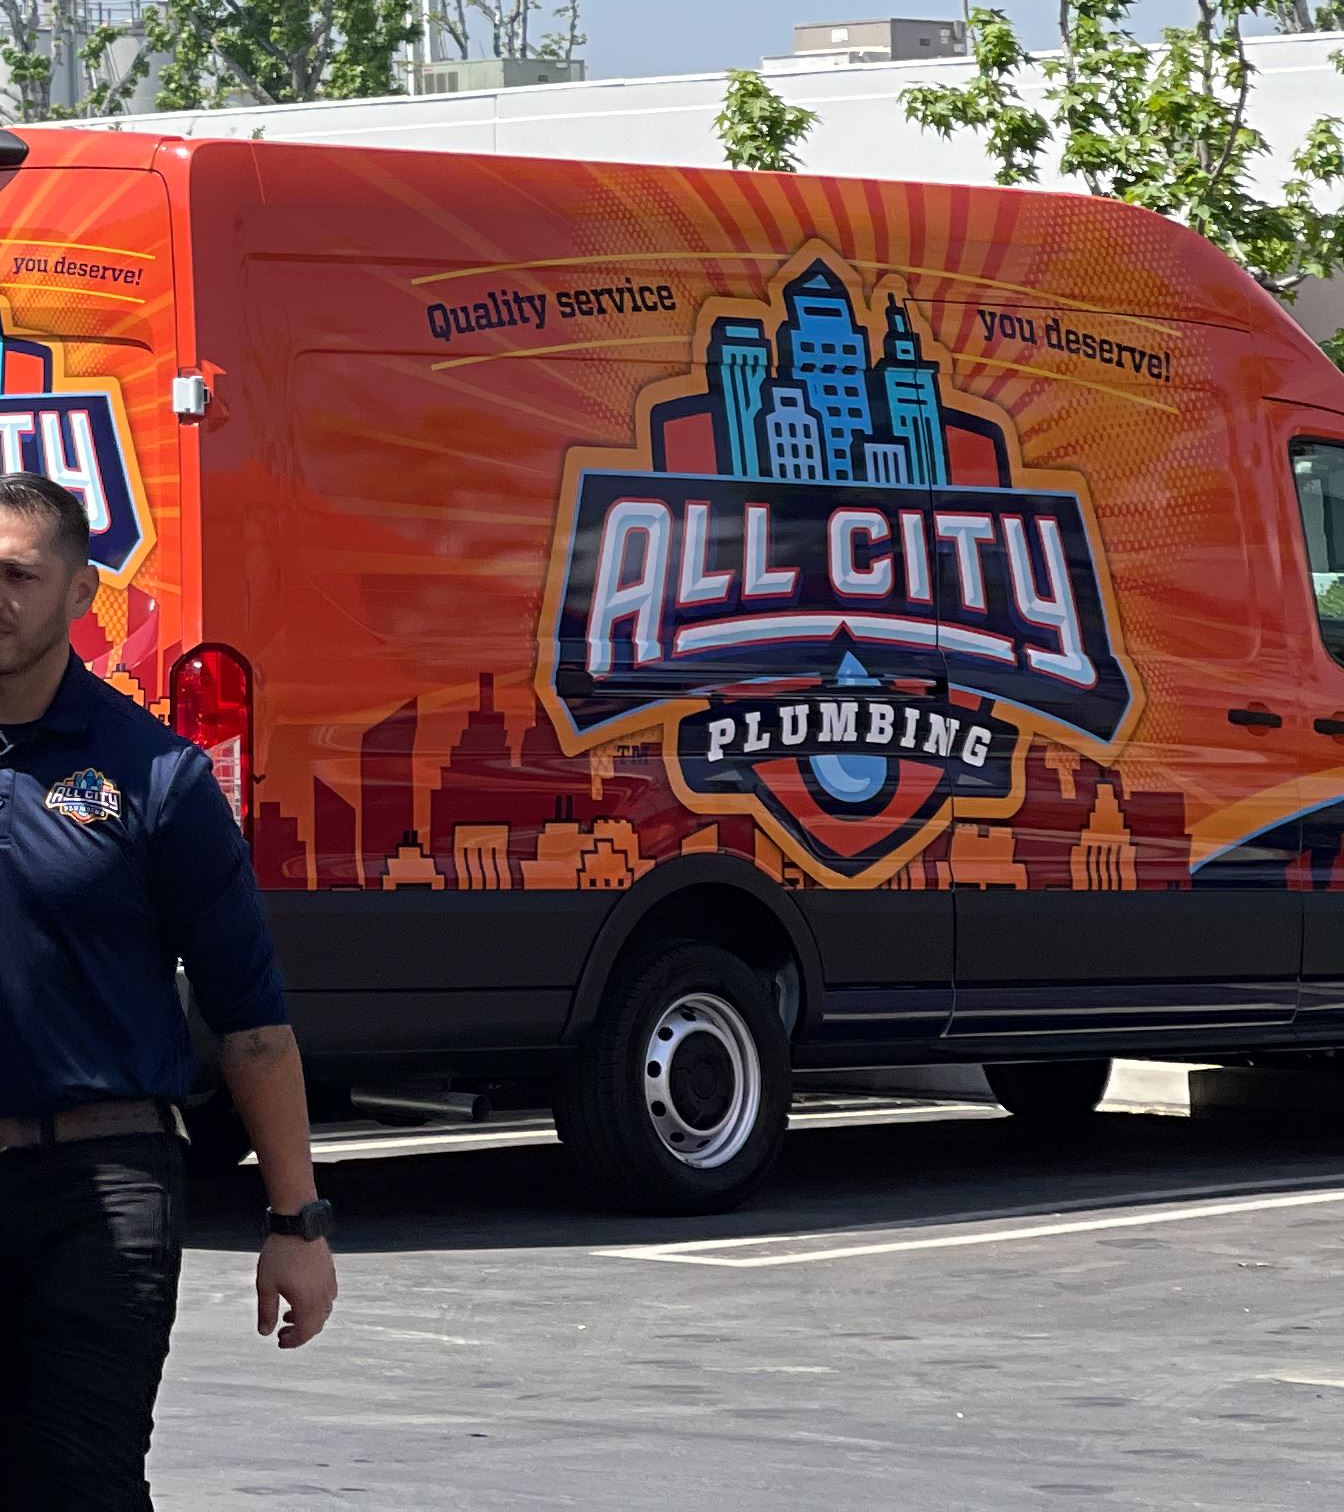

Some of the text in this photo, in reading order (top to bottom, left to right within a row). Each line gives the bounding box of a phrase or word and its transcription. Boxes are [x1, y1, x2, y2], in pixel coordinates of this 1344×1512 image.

[13, 256, 144, 286] you deserve!
[427, 281, 677, 341] Quality service
[978, 308, 1174, 383] you deserve!
[585, 497, 1100, 689] ALL CITY
[707, 701, 993, 769] PLUMBING
[52, 787, 119, 811] ALL CITY
